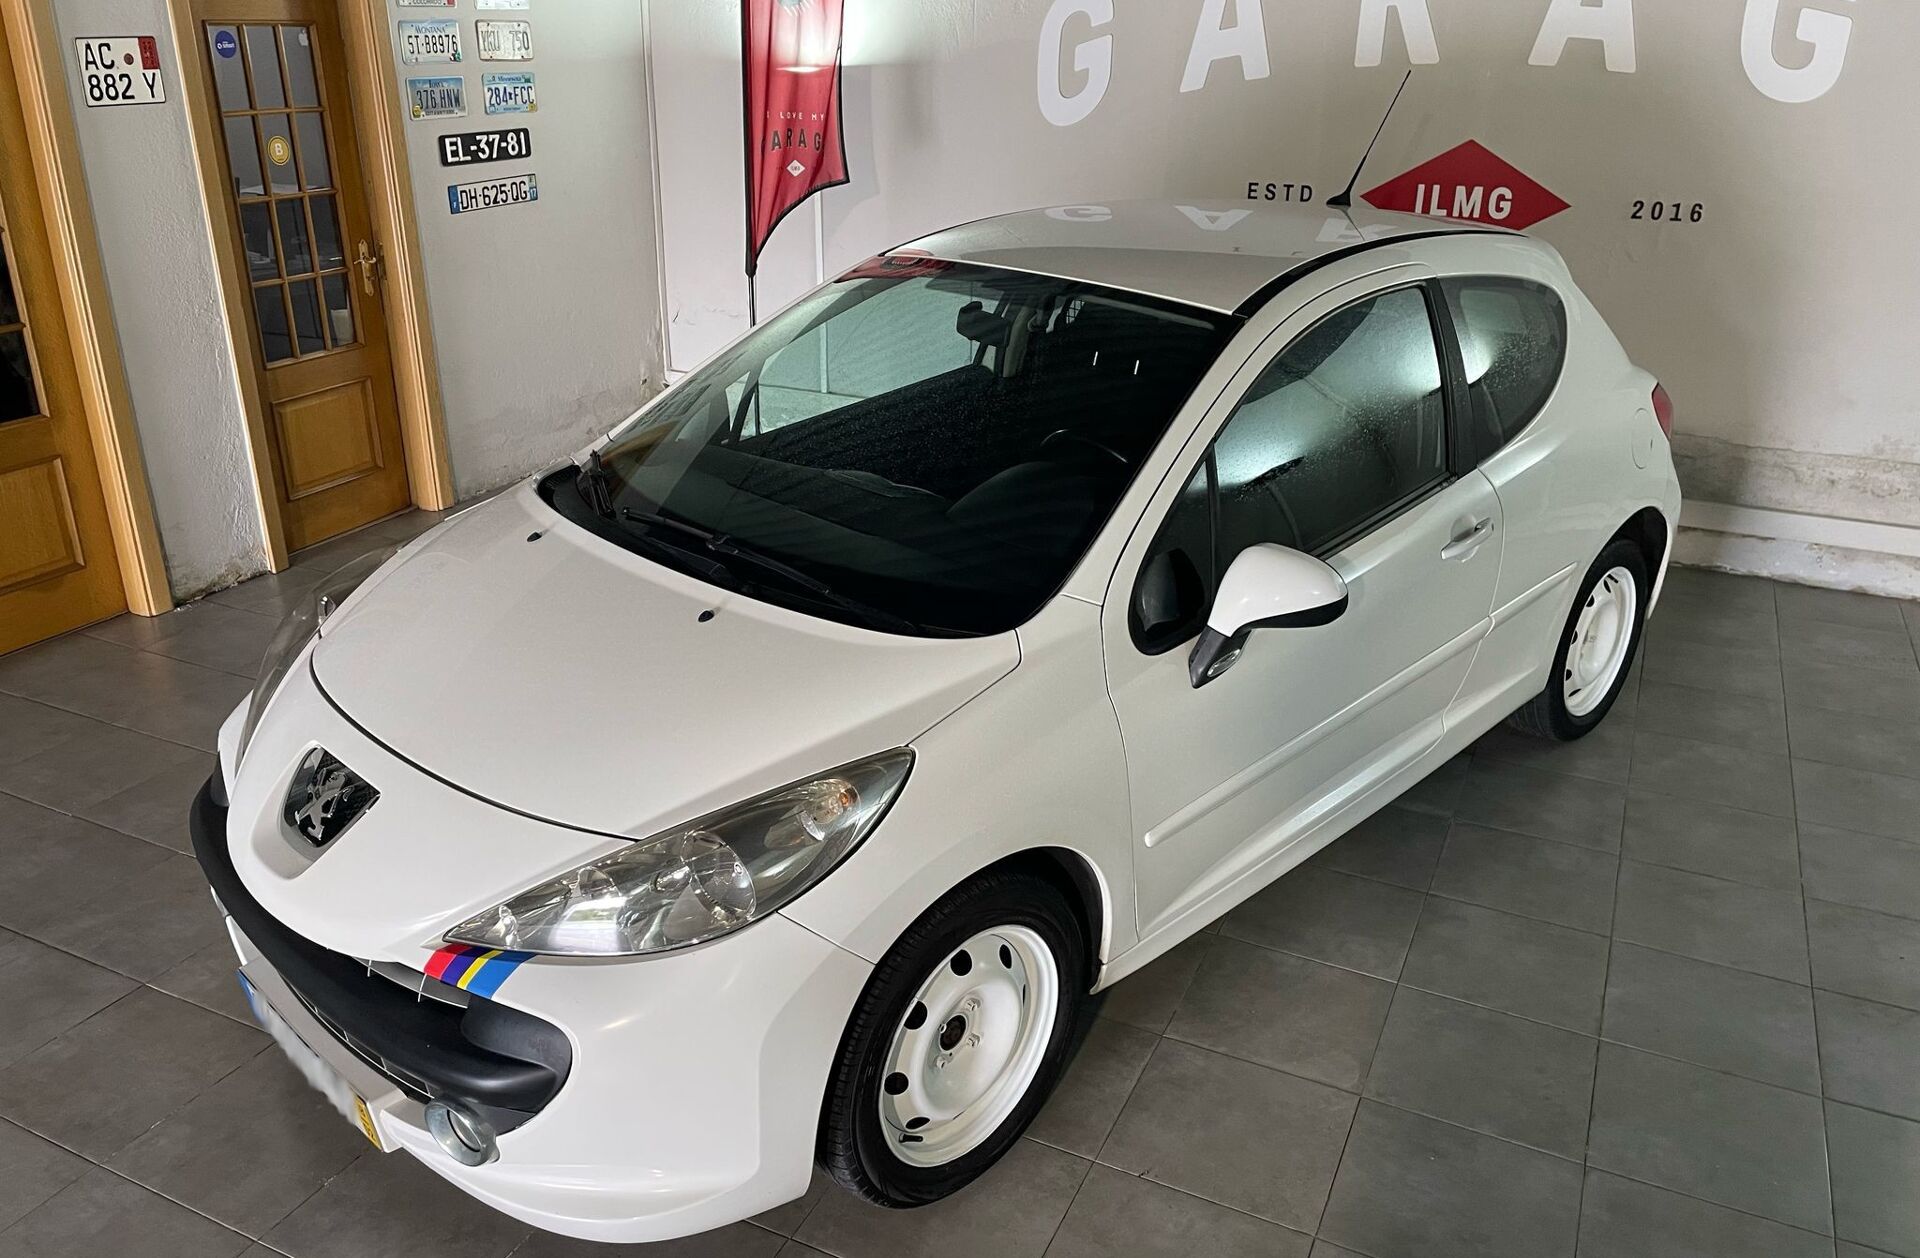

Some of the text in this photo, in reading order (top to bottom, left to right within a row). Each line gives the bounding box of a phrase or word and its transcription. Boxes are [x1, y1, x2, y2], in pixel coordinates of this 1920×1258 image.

[85, 41, 115, 70] AC
[88, 72, 156, 101] 882 Y
[416, 88, 461, 110] 376 HNW
[445, 132, 526, 163] EL-37-81
[762, 128, 822, 152] ARAG
[1247, 182, 1314, 203] ESTD
[1414, 183, 1513, 219] ILMG
[1630, 200, 1704, 223] 2016
